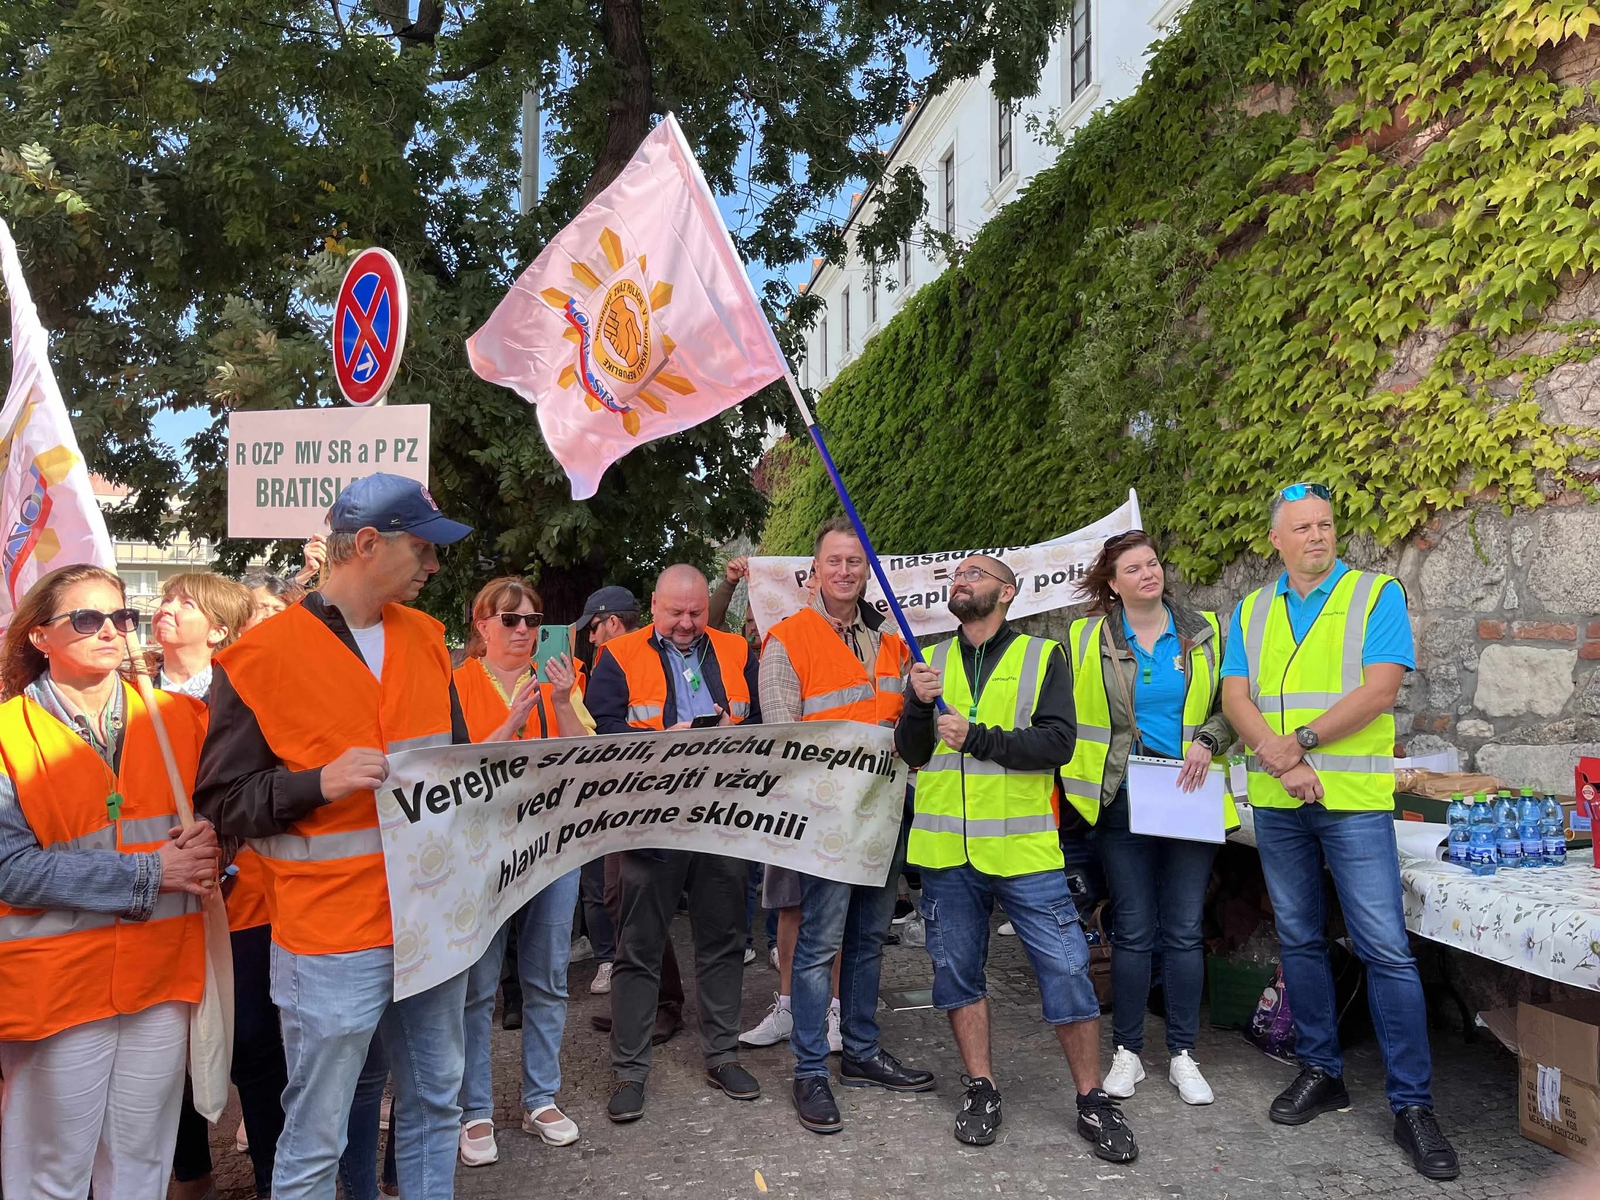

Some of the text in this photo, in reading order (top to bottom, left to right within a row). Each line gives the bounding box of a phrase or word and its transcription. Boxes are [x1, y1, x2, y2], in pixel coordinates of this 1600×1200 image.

[236, 437, 419, 465] R OZP MV SR a P PZ
[392, 735, 897, 824] Verejne sľúbili, potichu nesplnili,
[516, 766, 781, 824] veď policajti vždy
[497, 800, 809, 893] hlavu pokorne sklonili
